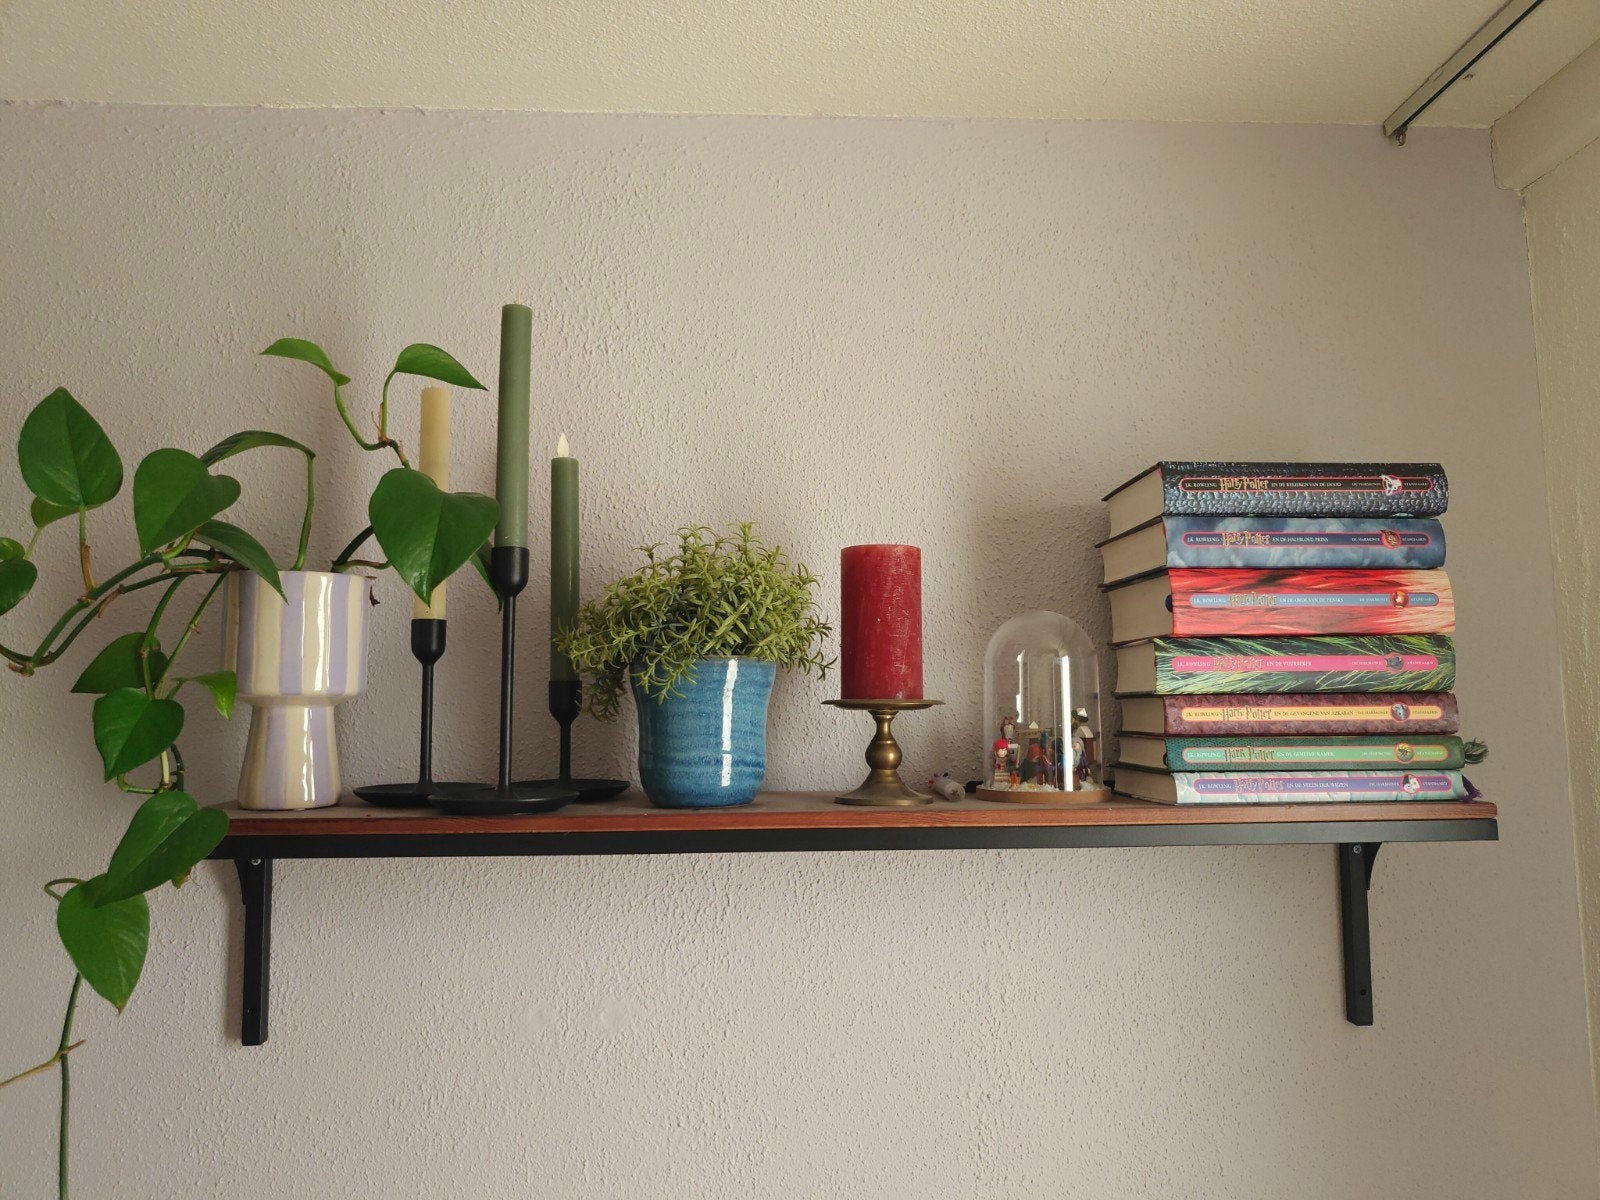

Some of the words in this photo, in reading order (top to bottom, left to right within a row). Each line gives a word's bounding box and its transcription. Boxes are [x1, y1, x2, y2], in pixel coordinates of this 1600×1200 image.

[1220, 478, 1243, 492] Harry
[1242, 476, 1269, 491] Potter
[1222, 532, 1244, 546] Harry
[1243, 530, 1271, 546] Potter
[1221, 706, 1245, 720] Harry
[1245, 705, 1272, 720] Potter
[1224, 747, 1247, 762] Harry
[1246, 746, 1275, 761] Potter
